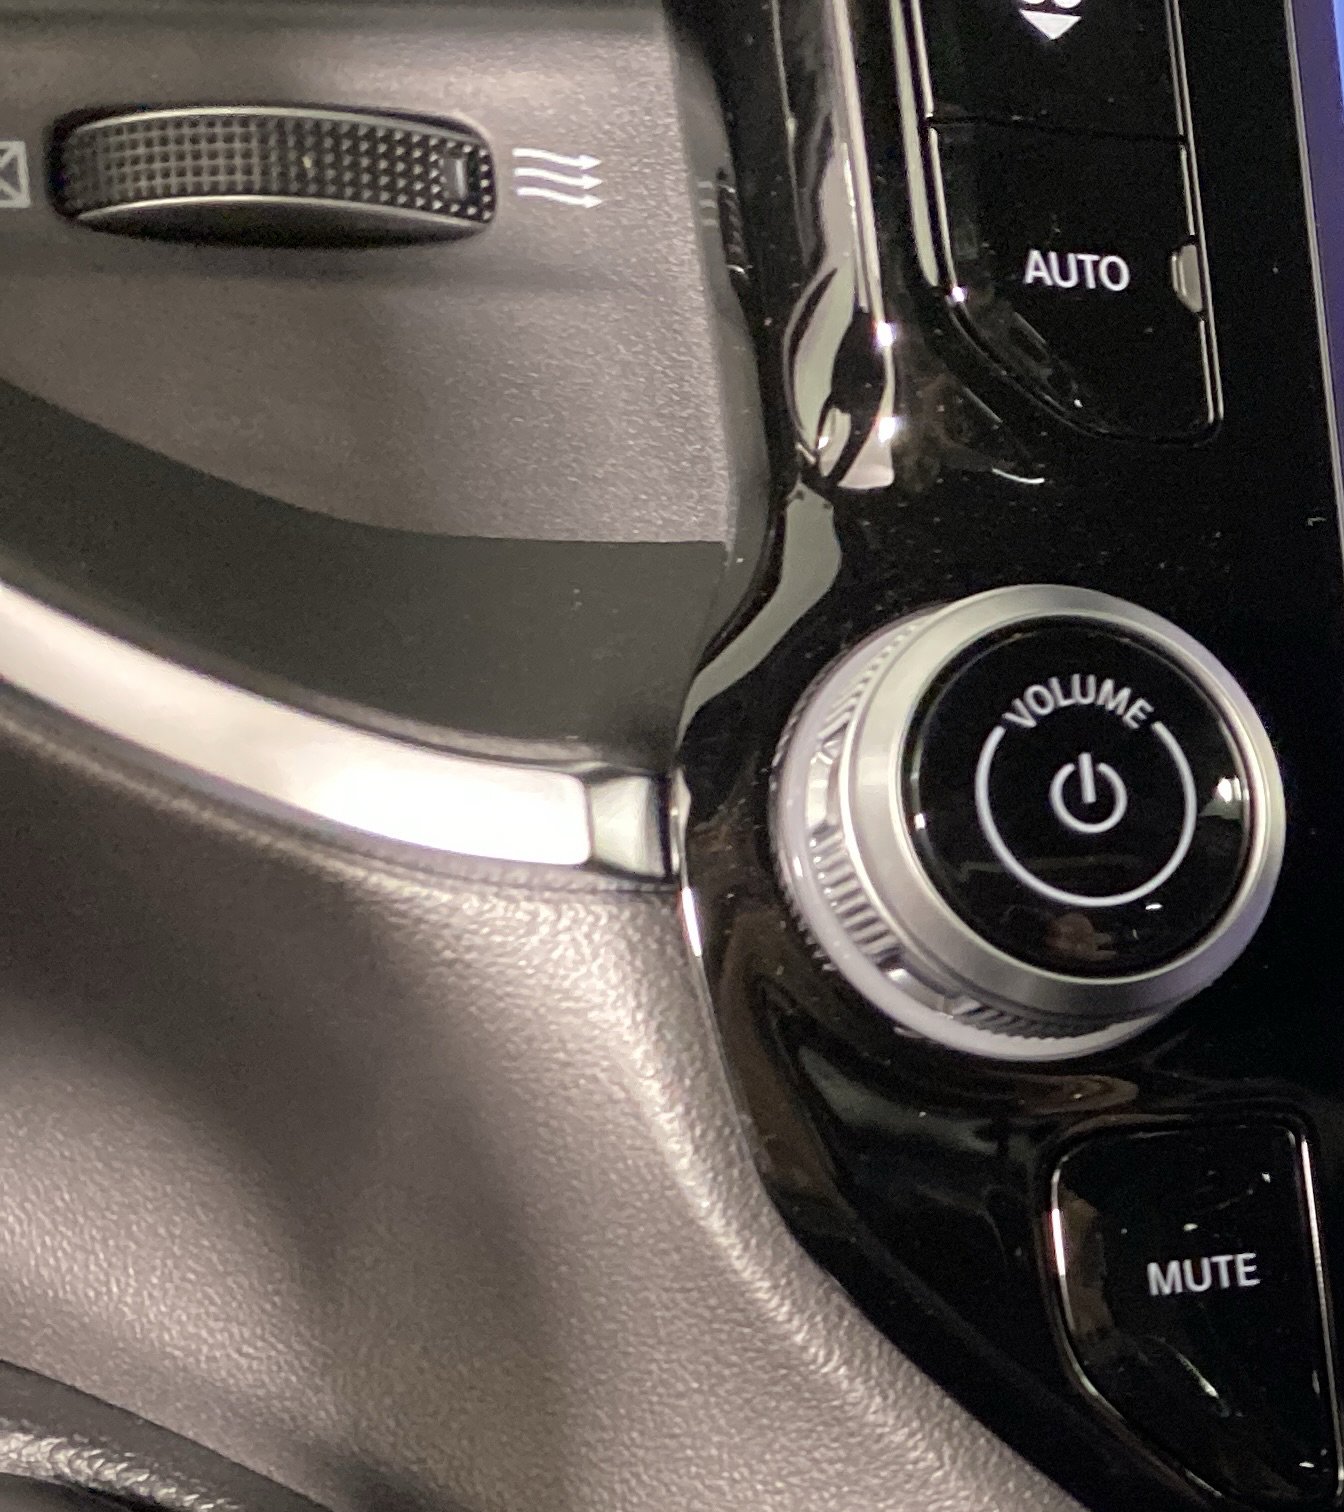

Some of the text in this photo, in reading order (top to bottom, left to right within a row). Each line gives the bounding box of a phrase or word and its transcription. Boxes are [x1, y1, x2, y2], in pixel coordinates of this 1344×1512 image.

[1023, 248, 1131, 293] AUTO
[1003, 673, 1157, 731] VOLUME
[1147, 1252, 1261, 1296] MUTE
